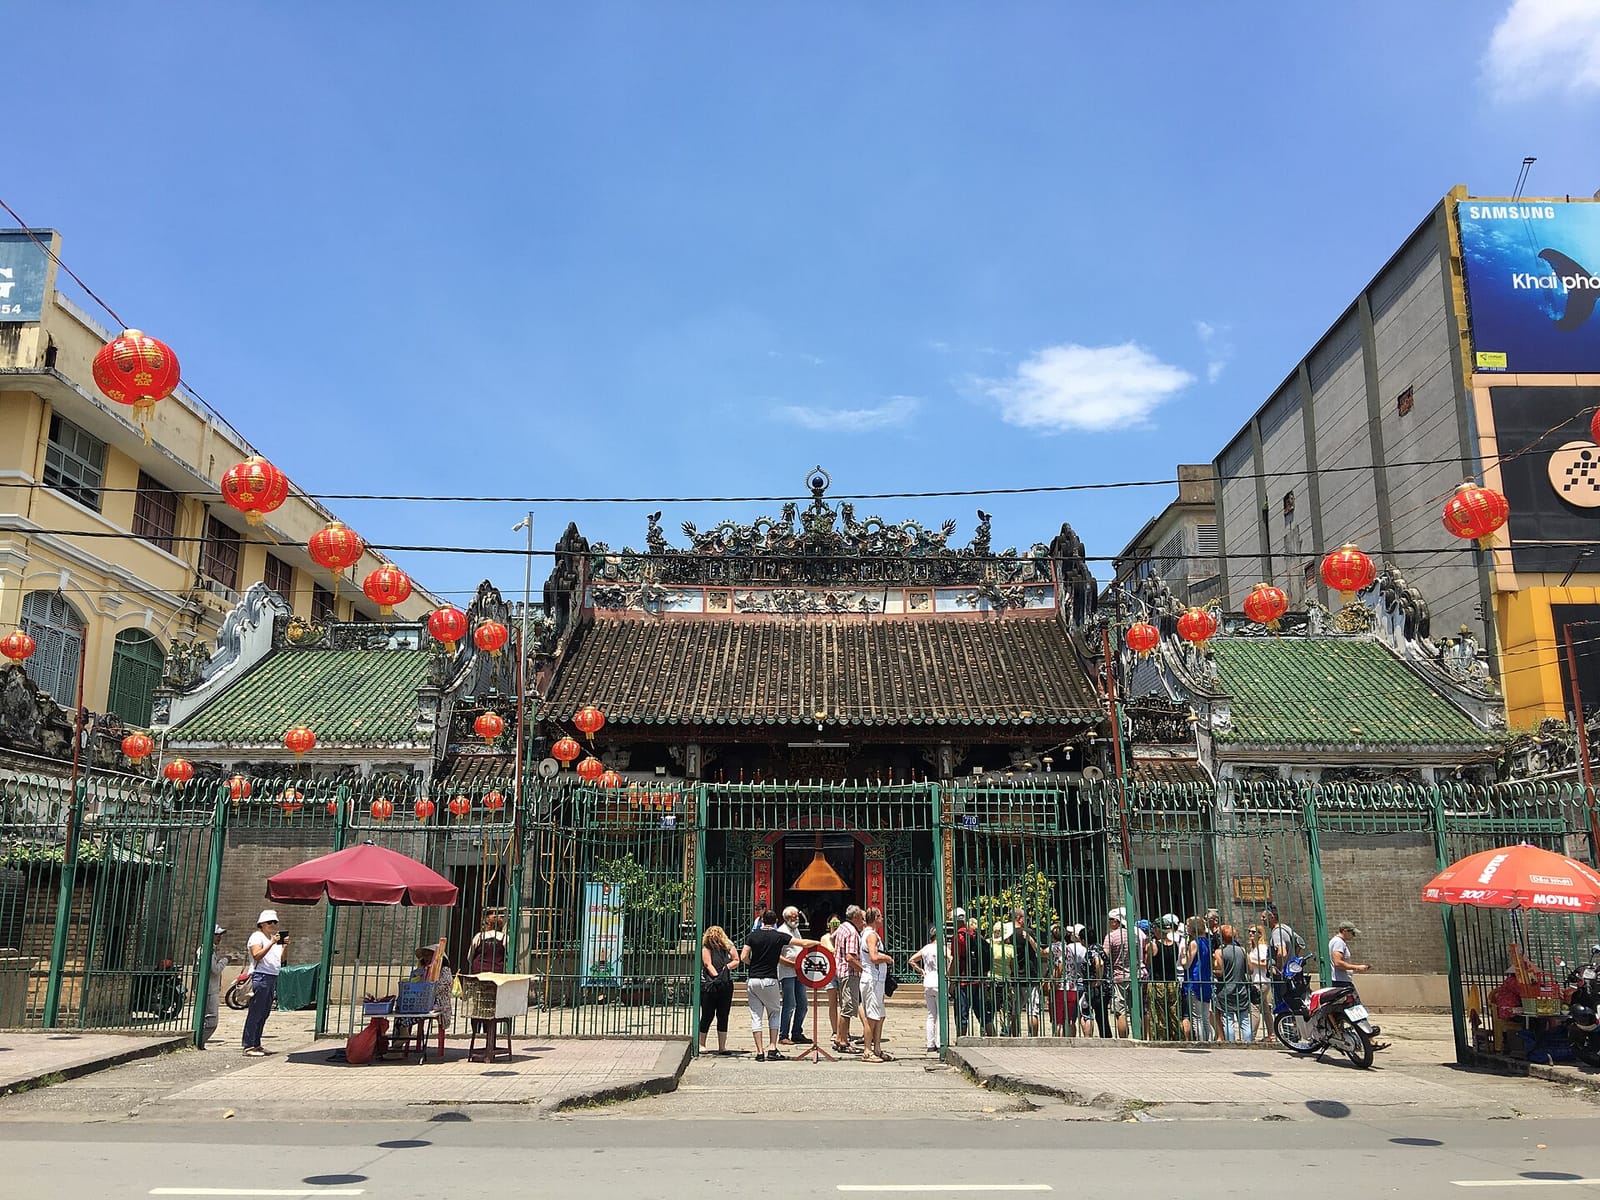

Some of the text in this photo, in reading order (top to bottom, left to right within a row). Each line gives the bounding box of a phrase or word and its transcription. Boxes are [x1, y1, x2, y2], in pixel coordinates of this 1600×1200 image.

[1469, 206, 1555, 219] SAMSUNG
[1512, 271, 1558, 289] Khai
[1533, 894, 1582, 907] MOTUL
